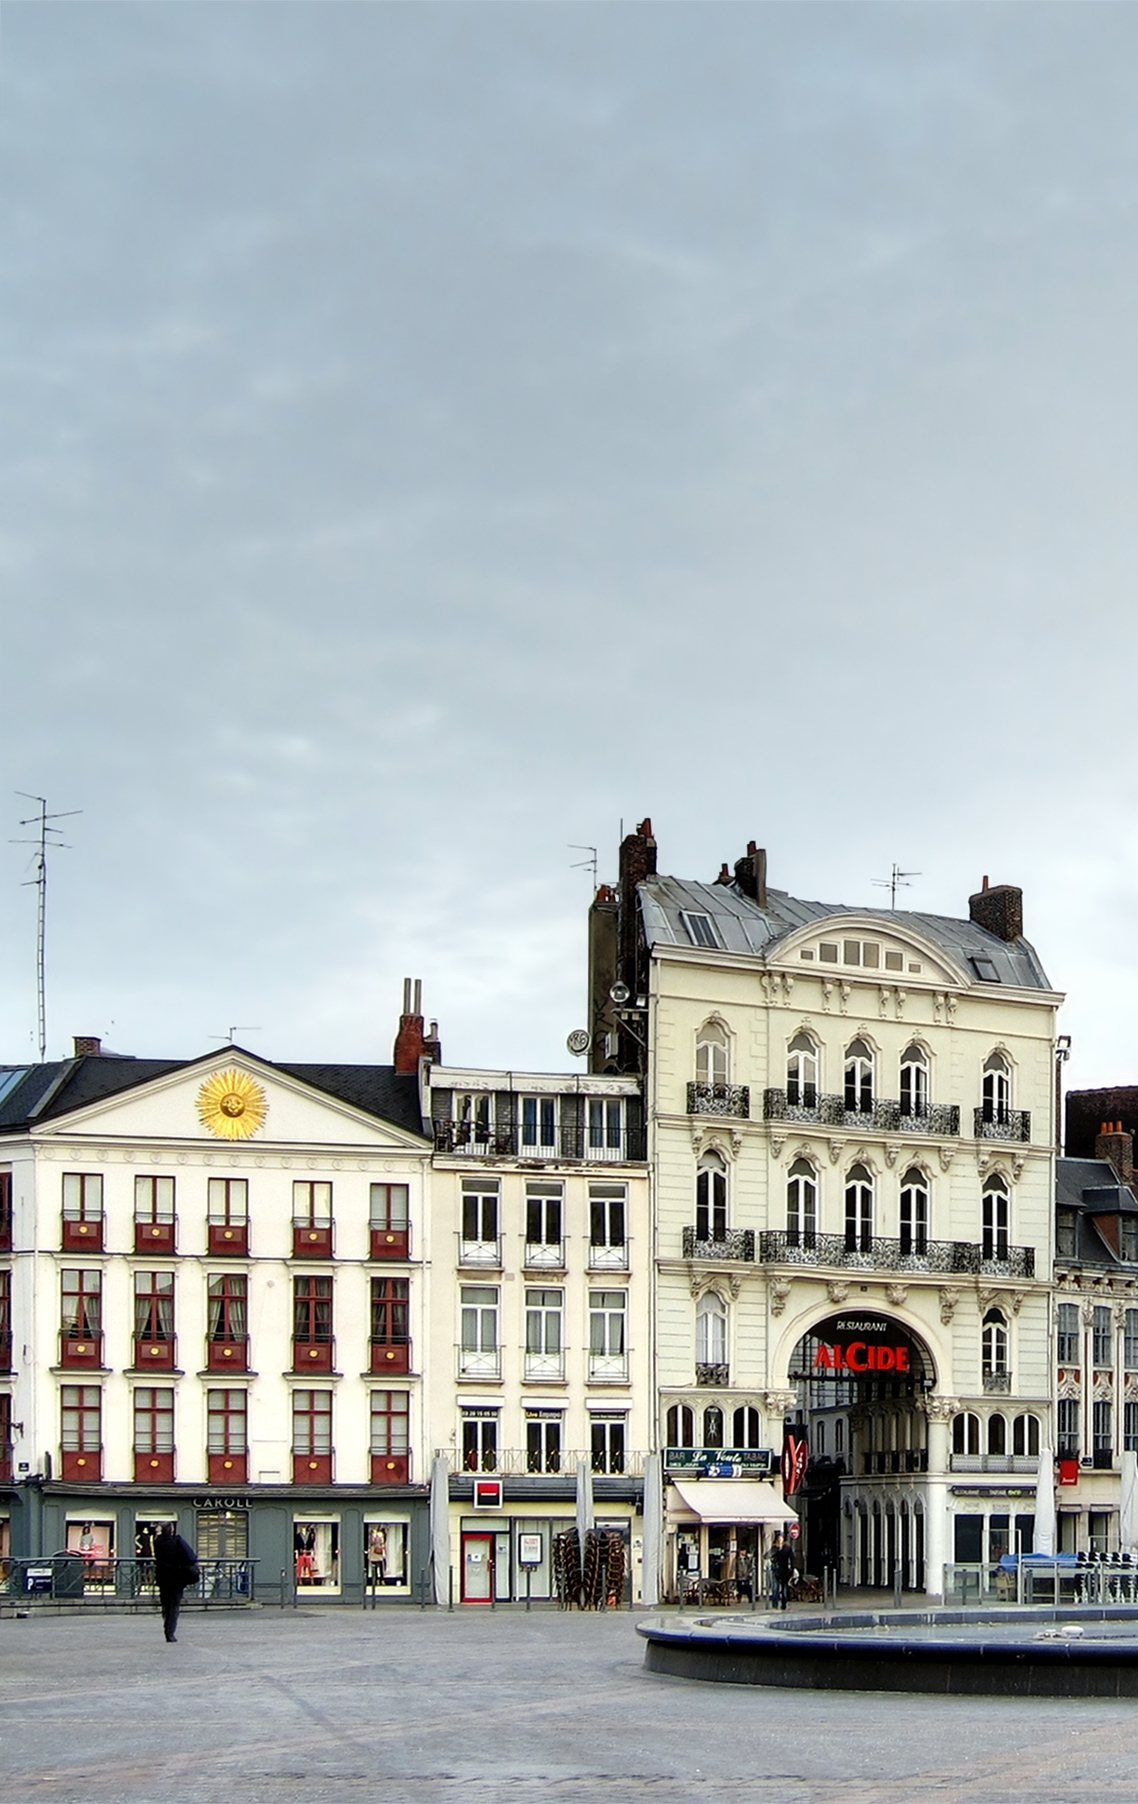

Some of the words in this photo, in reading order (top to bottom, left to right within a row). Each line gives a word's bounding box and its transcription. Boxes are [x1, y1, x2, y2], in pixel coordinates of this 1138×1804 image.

[836, 1320, 888, 1332] RESTAURANT
[813, 1341, 910, 1372] ALCIDE
[668, 1452, 686, 1460] BAR
[691, 1450, 708, 1462] La
[743, 1453, 767, 1461] TABAC
[193, 1498, 253, 1508] CAROLL
